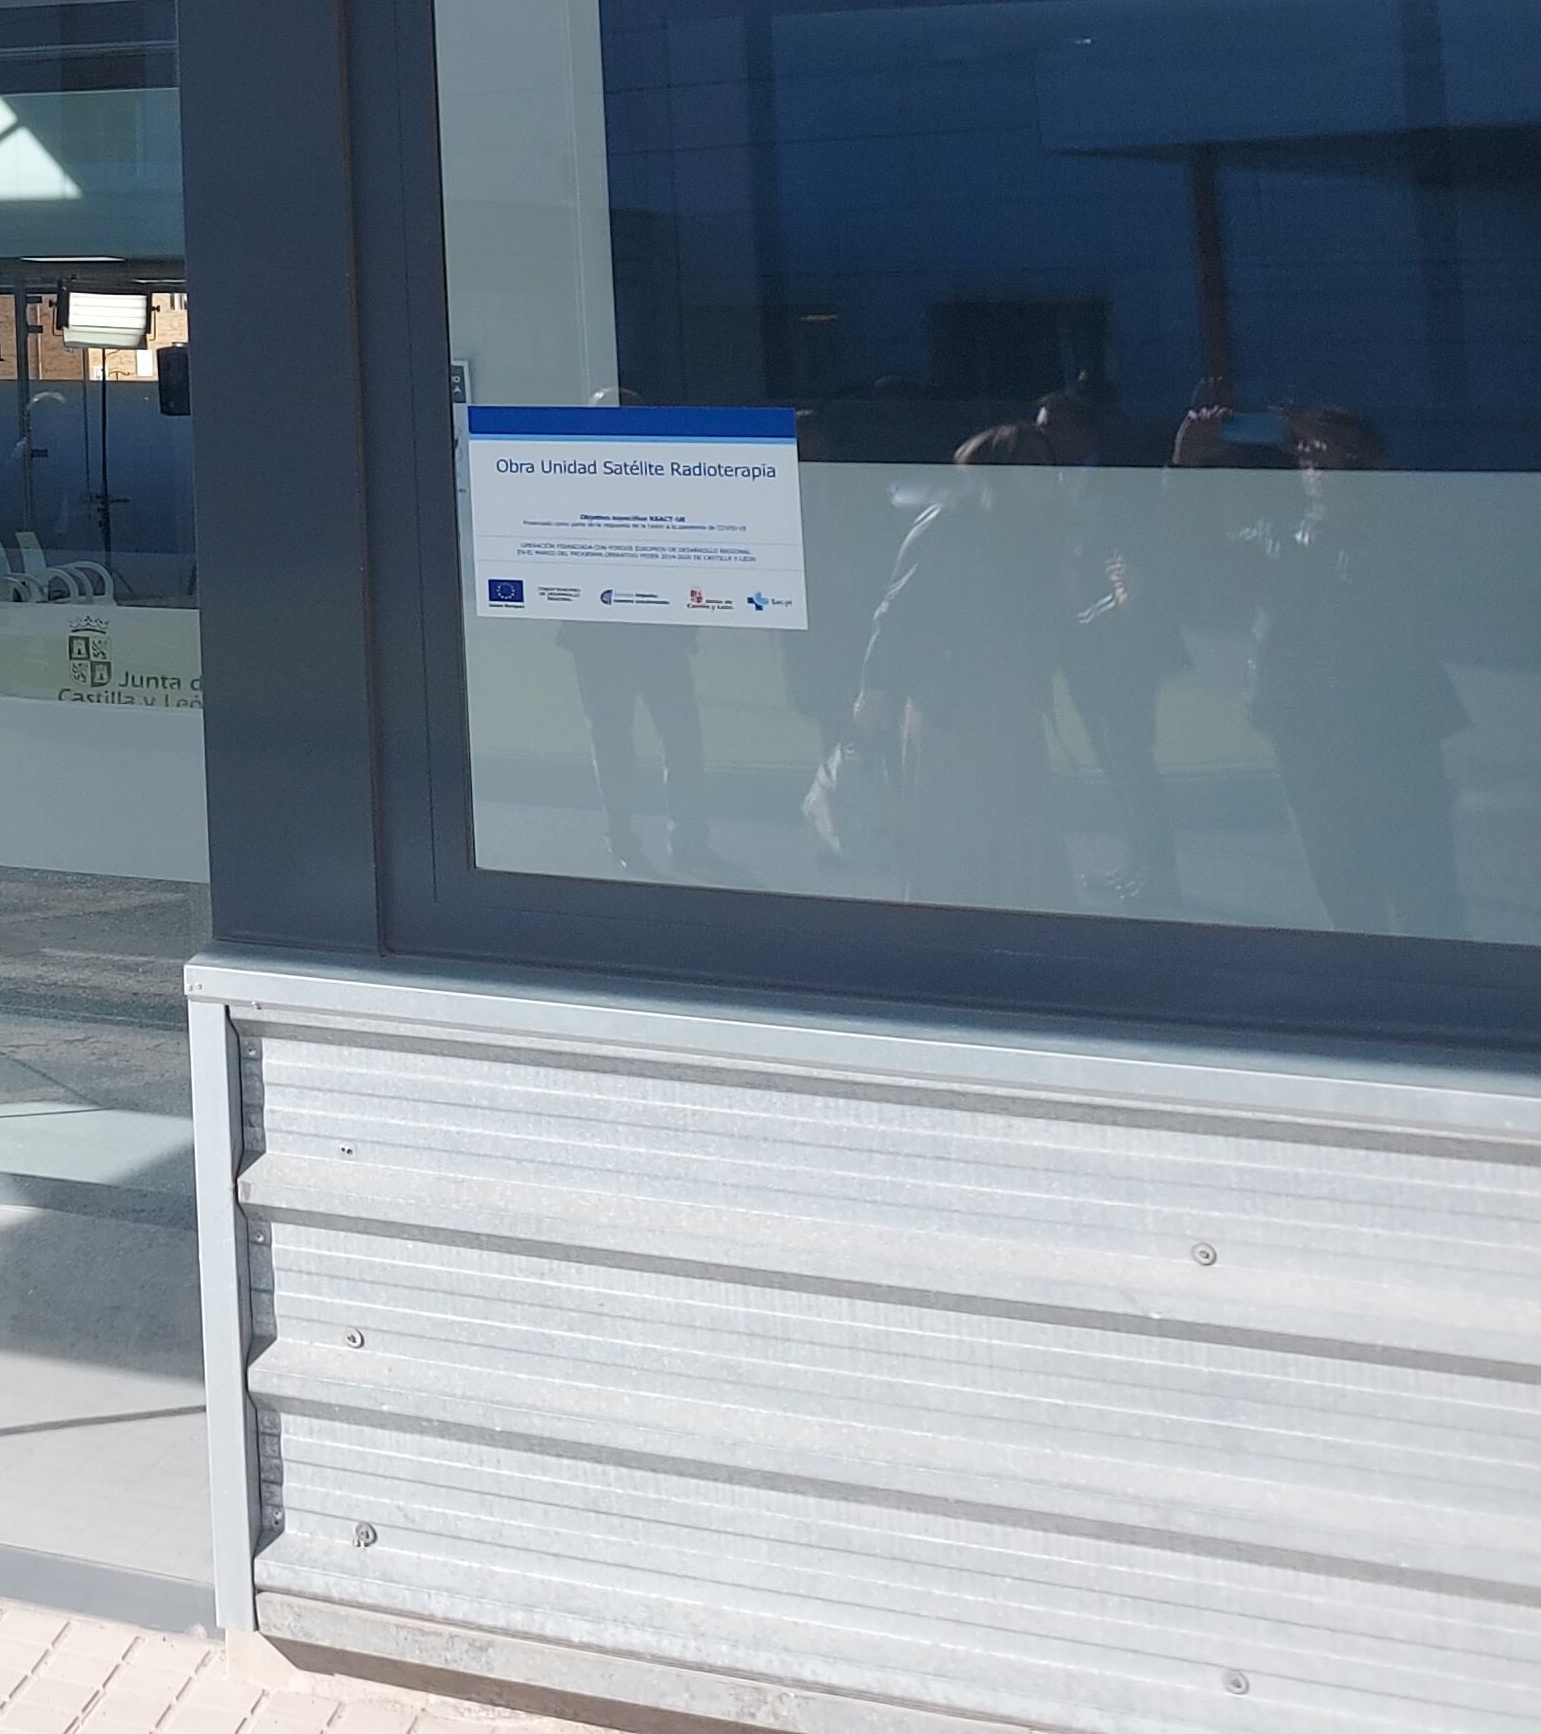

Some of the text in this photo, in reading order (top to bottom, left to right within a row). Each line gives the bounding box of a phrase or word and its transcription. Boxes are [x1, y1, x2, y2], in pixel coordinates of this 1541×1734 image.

[496, 458, 777, 481] Obra Unidad Satélite Radioterapia
[118, 671, 182, 691] Junta
